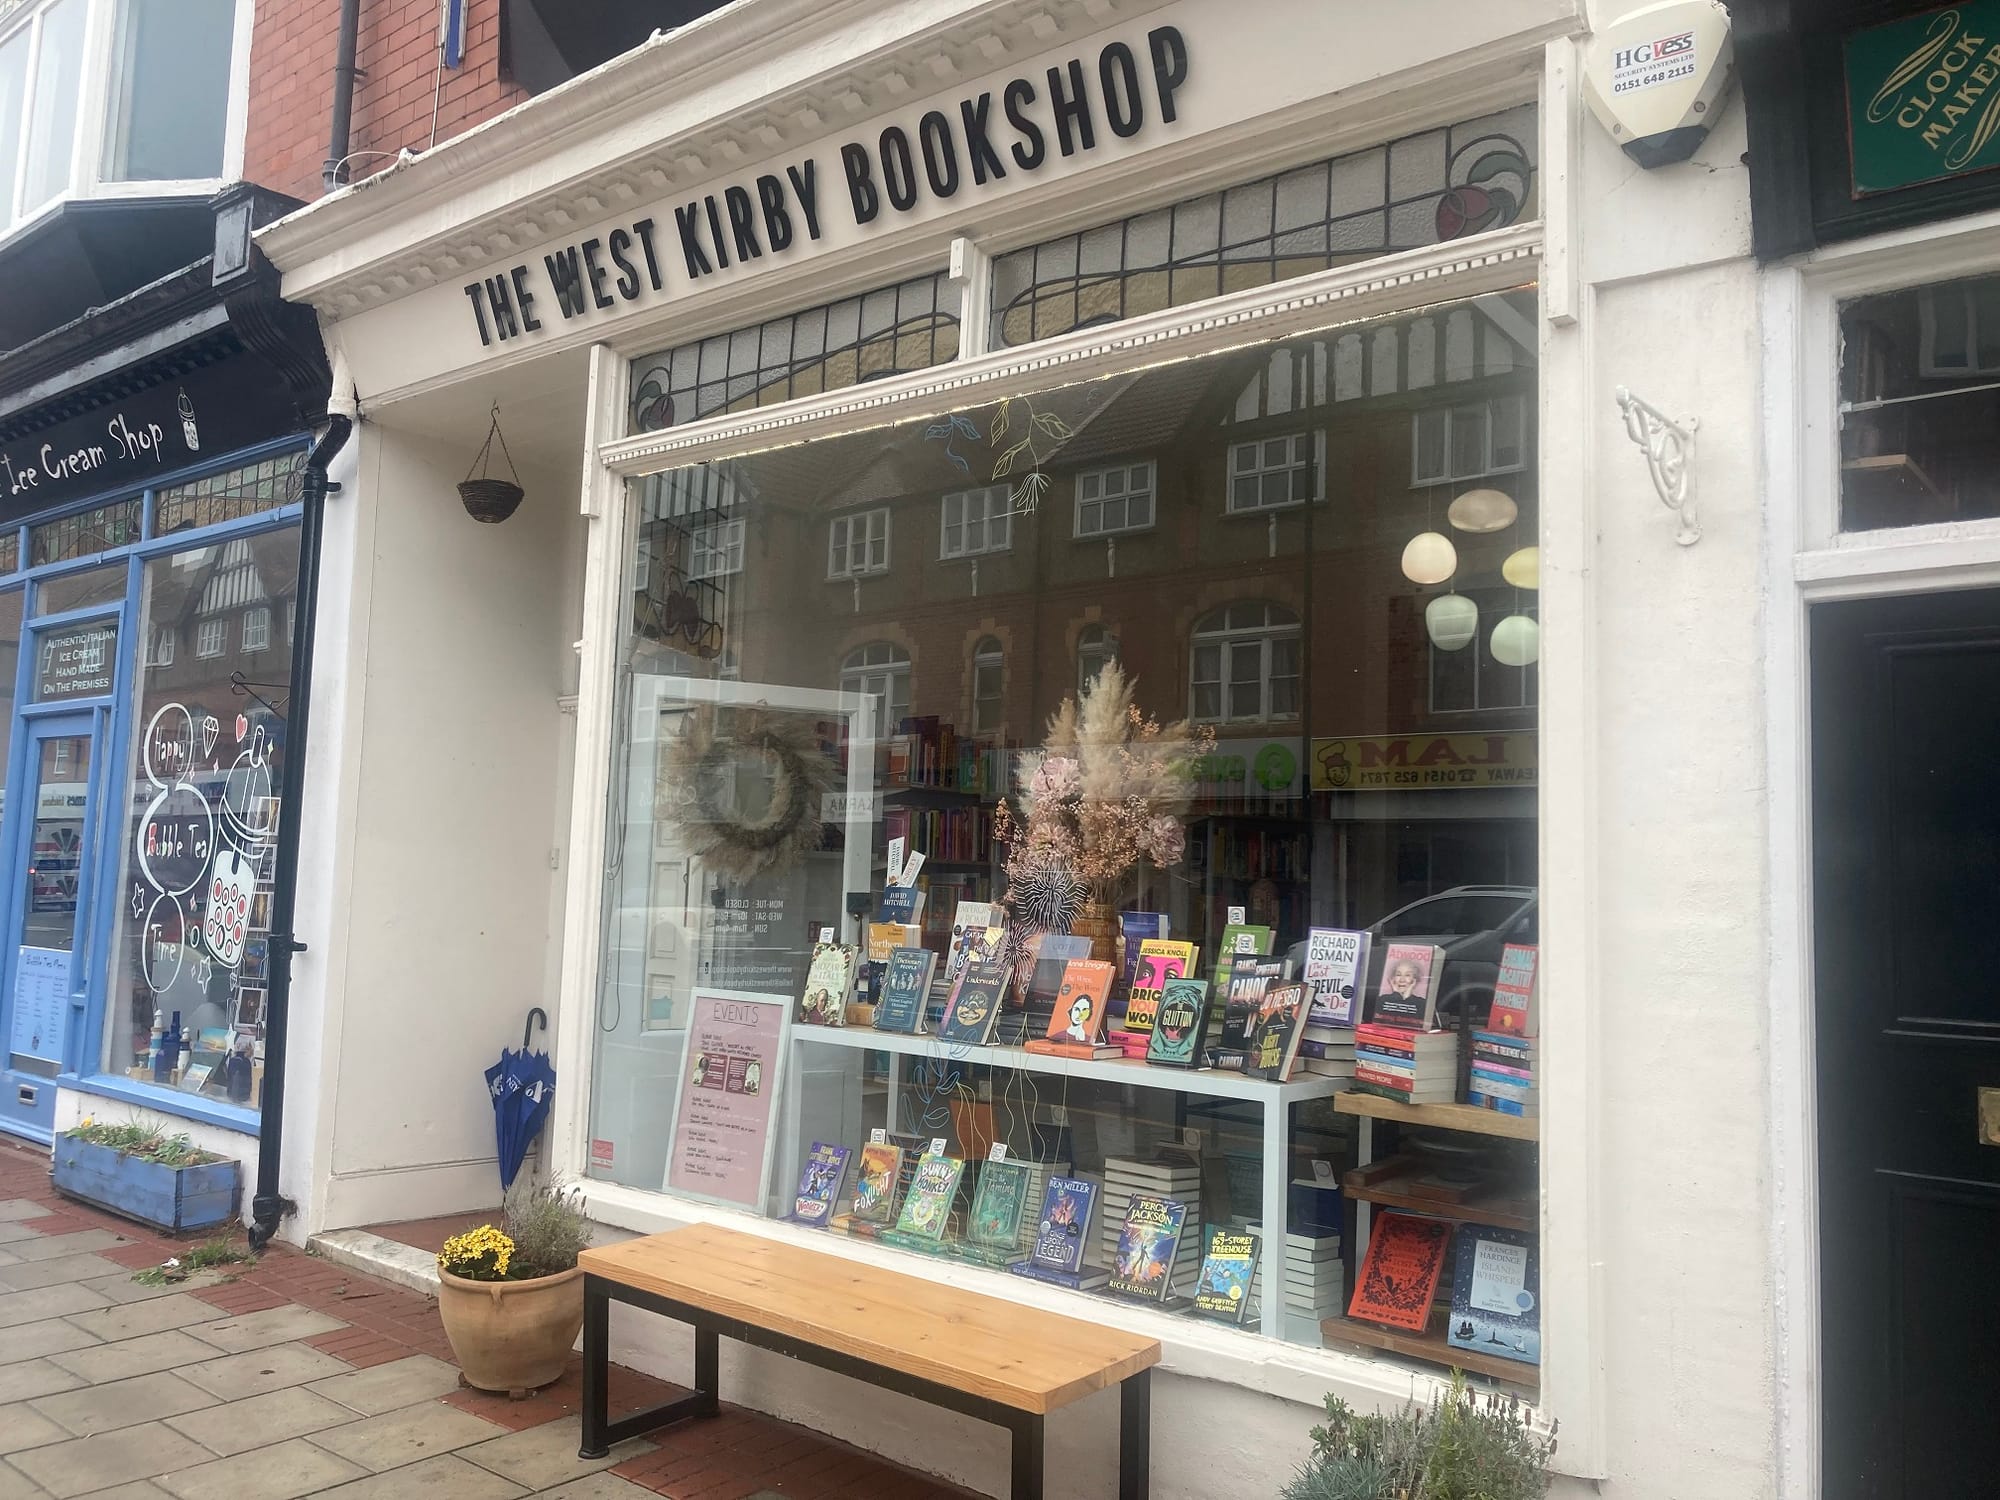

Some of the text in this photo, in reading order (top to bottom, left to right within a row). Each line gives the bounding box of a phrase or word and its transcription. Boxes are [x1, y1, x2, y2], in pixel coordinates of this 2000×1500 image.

[1614, 54, 1695, 80] SECURITY SYSTEMS LTD
[1614, 63, 1694, 92] 0151 648 2115
[1897, 31, 1985, 129] CLOCK
[464, 25, 1189, 347] THE WEST KIRBY BOOKSHOP
[1, 413, 164, 496] Ice Cream Shop
[47, 630, 117, 650] AUTHENTIC ITALIAN
[59, 649, 101, 662] ICE CREAM
[55, 664, 102, 677] HAND MADE
[43, 678, 109, 694] ON THE PREMISES
[155, 726, 185, 773] Happy
[146, 822, 207, 859] Bubble Tea
[884, 899, 911, 908] MITCHELL
[890, 892, 908, 900] DAVID
[151, 923, 177, 962] Time
[869, 938, 904, 949] Northern
[869, 948, 890, 960] Wind
[1141, 947, 1188, 957] JESSICA KNOLL
[1310, 948, 1354, 963] OSMAN
[1084, 961, 1108, 970] Enright
[1308, 964, 1331, 978] Last
[713, 1002, 759, 1025] EVENTS
[1162, 1009, 1195, 1028] GLUTTON
[921, 1163, 955, 1180] BUNNY
[854, 1171, 892, 1213] FOXLIGHT
[916, 1176, 951, 1195] MONKEY
[1049, 1180, 1090, 1194] BEN MILLER
[1140, 1200, 1168, 1215] PERCY
[1129, 1210, 1174, 1226] JACKSON
[1045, 1236, 1062, 1246] UPON
[1050, 1230, 1066, 1240] ONCE
[1212, 1236, 1254, 1246] 169-STOREY
[1035, 1238, 1075, 1265] LEGEND
[1211, 1245, 1253, 1255] TREEHOUSE
[1109, 1280, 1158, 1297] RICK RIORDAN
